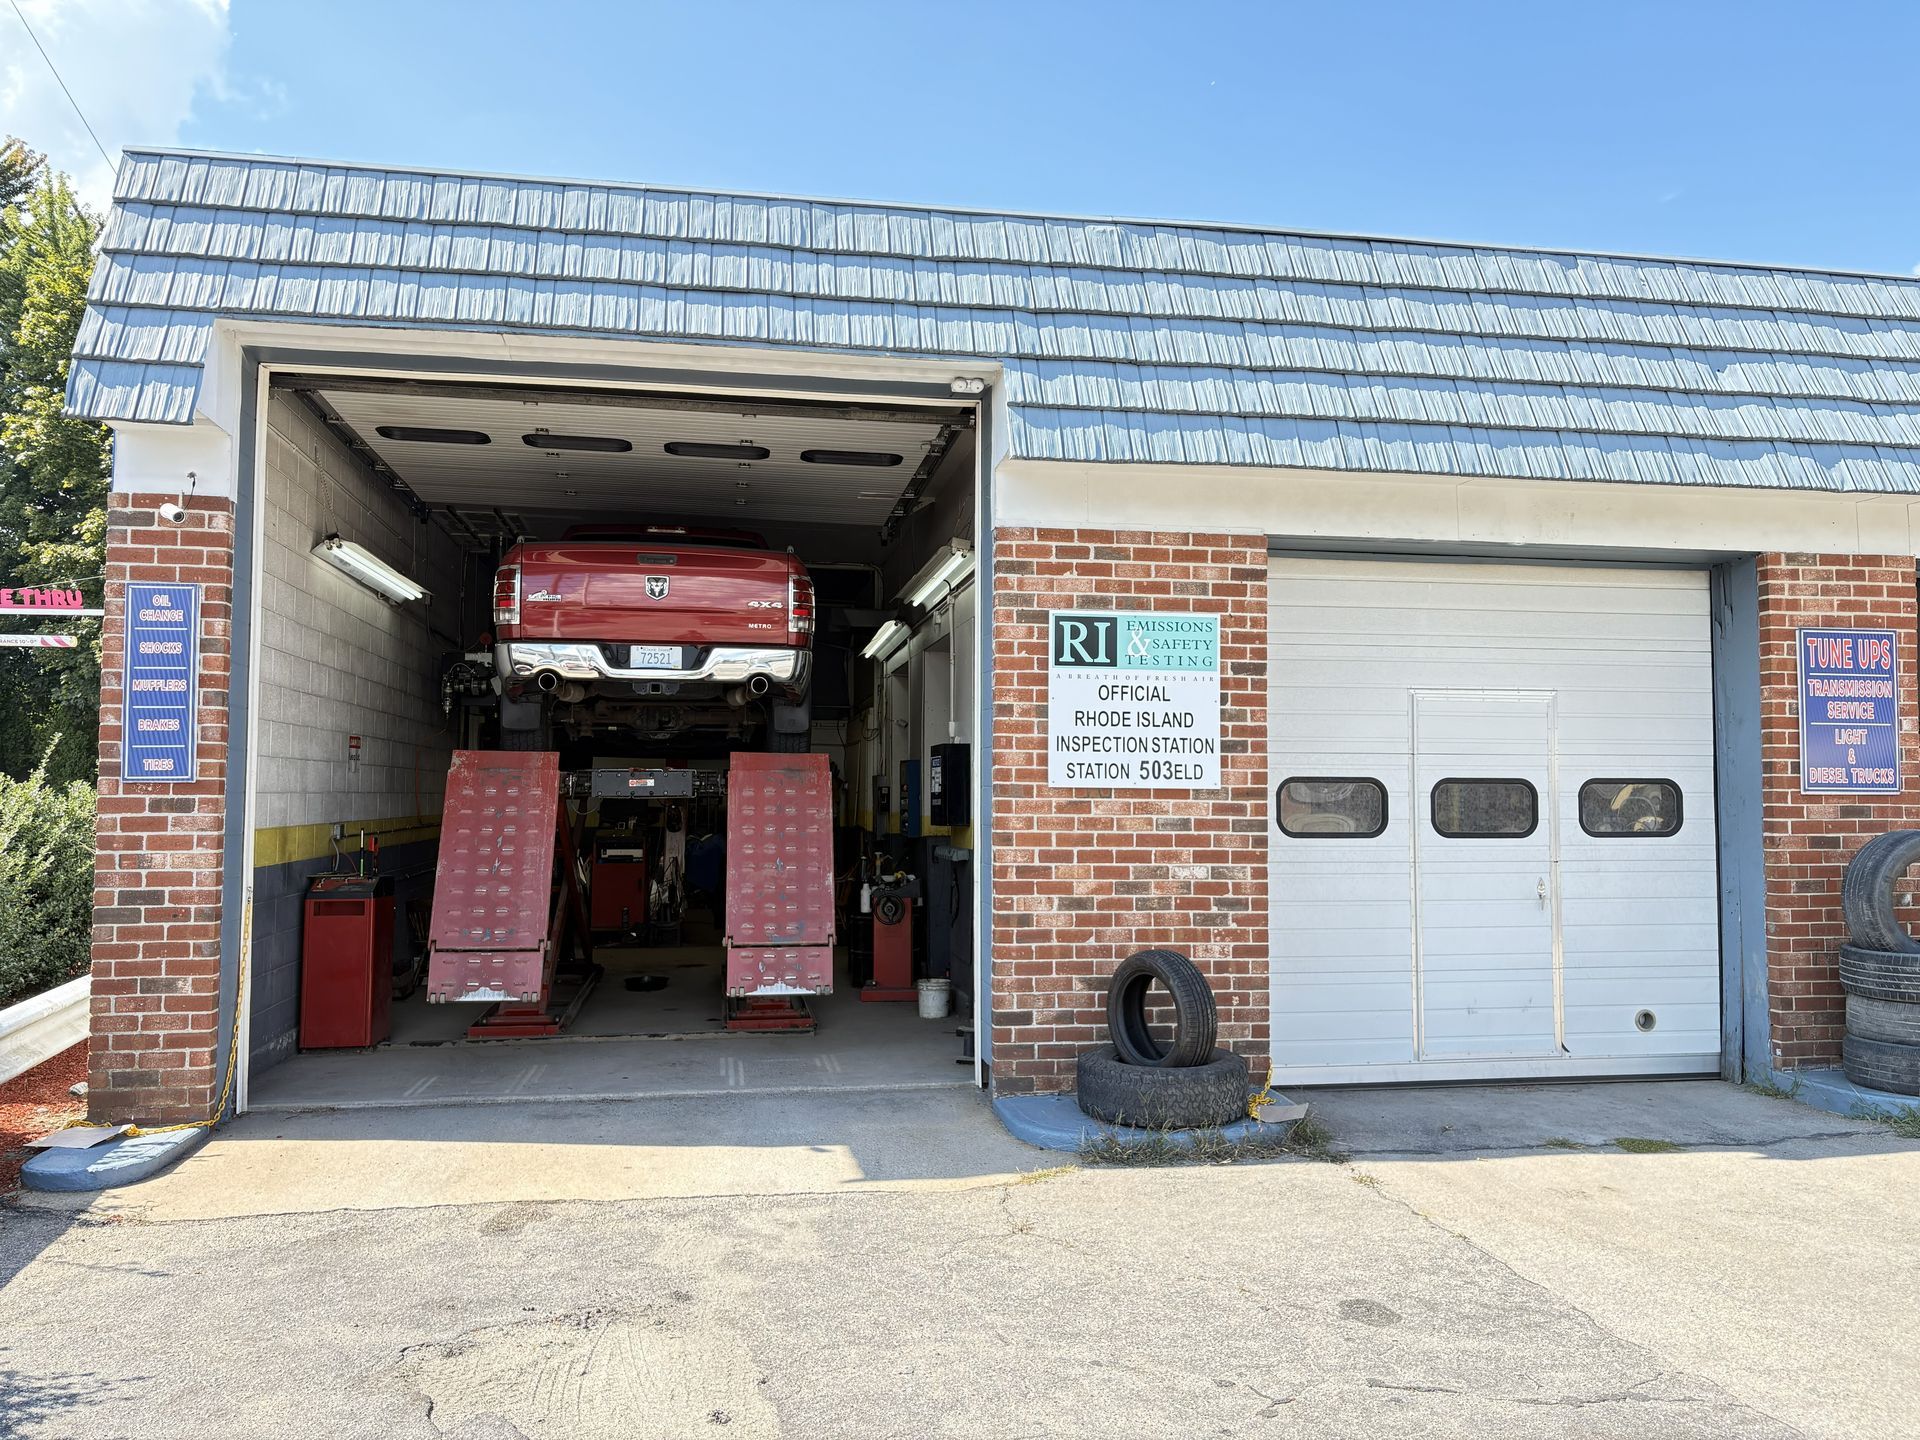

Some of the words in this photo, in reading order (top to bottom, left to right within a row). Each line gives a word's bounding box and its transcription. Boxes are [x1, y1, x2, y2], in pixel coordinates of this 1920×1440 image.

[19, 588, 83, 606] THRU
[152, 594, 171, 607] OIL
[139, 609, 183, 622] CHANGE
[1126, 620, 1213, 633] EMISSIONS
[139, 642, 183, 654] SHOCKS
[1058, 621, 1112, 663] RI
[1127, 627, 1151, 658] &
[1152, 638, 1213, 651] SAFETY
[640, 652, 672, 665] 72521
[1125, 654, 1213, 667] TESTING
[1807, 637, 1853, 669] TUNE
[1857, 639, 1891, 670] UPS
[1068, 673, 1118, 681] BREATH
[132, 680, 187, 692] MUFFLERS
[1098, 684, 1171, 702] OFFICIAL
[1807, 679, 1893, 698] TRANSMISSION
[1075, 710, 1131, 727] RHODE
[1137, 711, 1194, 728] ISLAND
[1827, 701, 1875, 720] SERVICE
[138, 719, 180, 731] BRAKES
[1056, 735, 1148, 753] INSPECTION
[1151, 737, 1215, 754] STATION
[1835, 728, 1867, 745] LIGHT
[143, 759, 174, 770] TIRES
[1847, 748, 1857, 765] &
[1066, 762, 1130, 779] STATION
[1809, 767, 1849, 784] DIESEL
[1851, 767, 1895, 784] TRUCKS
